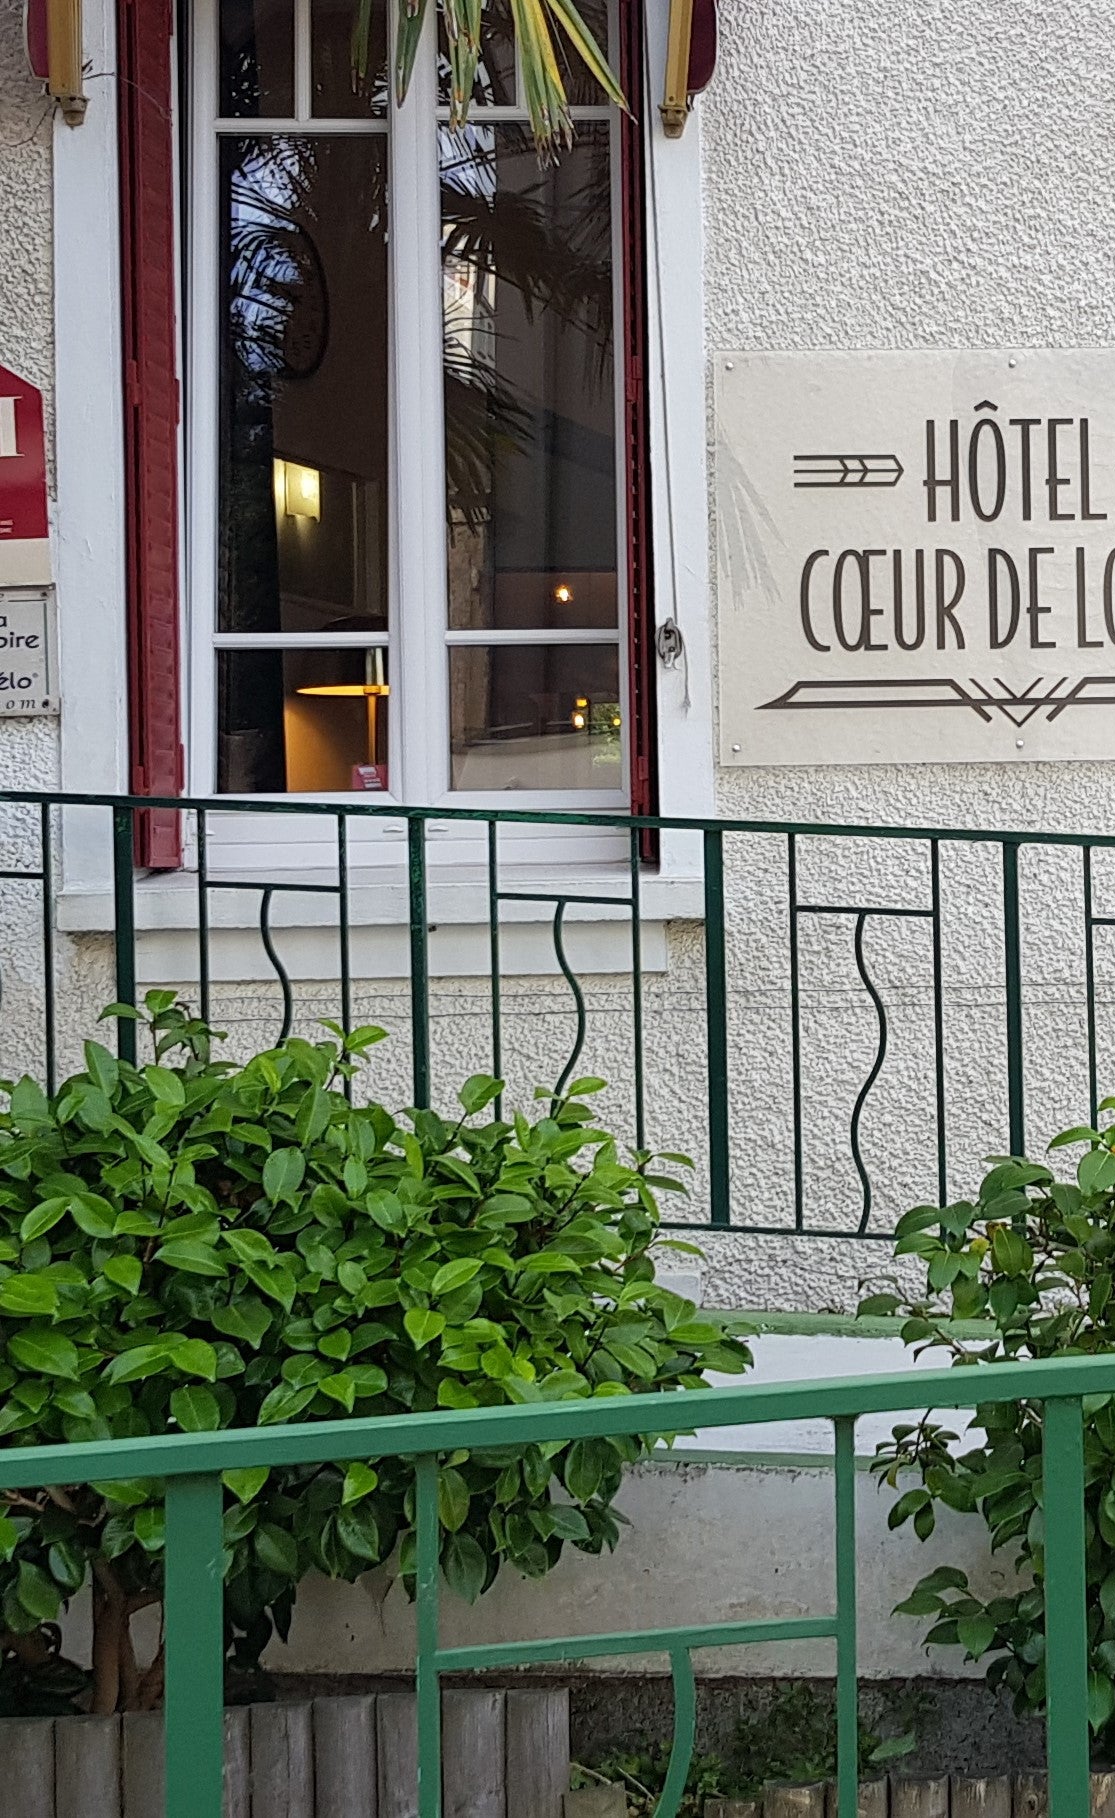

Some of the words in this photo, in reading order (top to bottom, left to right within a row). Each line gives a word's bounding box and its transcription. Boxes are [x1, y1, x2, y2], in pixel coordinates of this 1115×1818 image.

[922, 400, 1108, 522] HÔTEL
[800, 548, 966, 652] CŒUR
[987, 546, 1057, 650] DE
